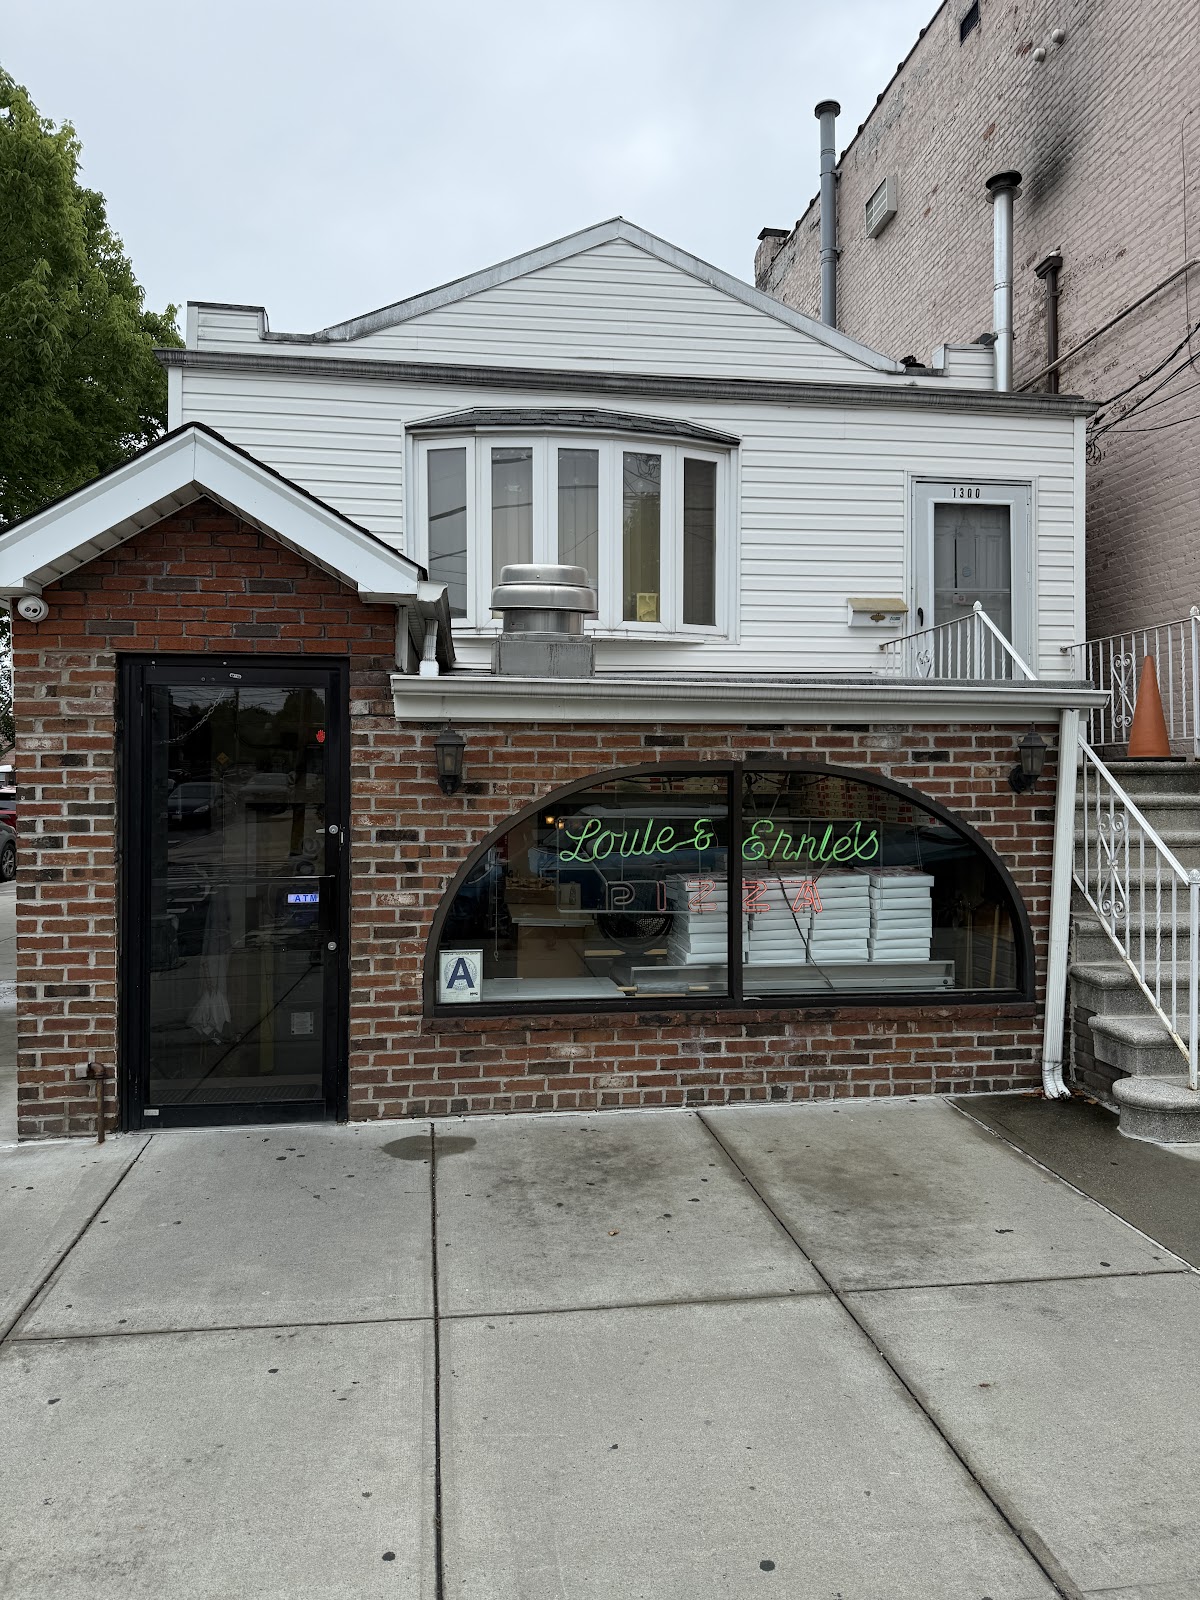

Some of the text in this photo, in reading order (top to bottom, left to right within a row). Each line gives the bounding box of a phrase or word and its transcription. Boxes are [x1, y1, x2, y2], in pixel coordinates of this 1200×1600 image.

[952, 487, 980, 499] 1300
[559, 818, 677, 862] Louie
[694, 818, 714, 850] &
[294, 894, 318, 902] ATM
[606, 880, 823, 912] PIZZA
[446, 957, 475, 989] A
